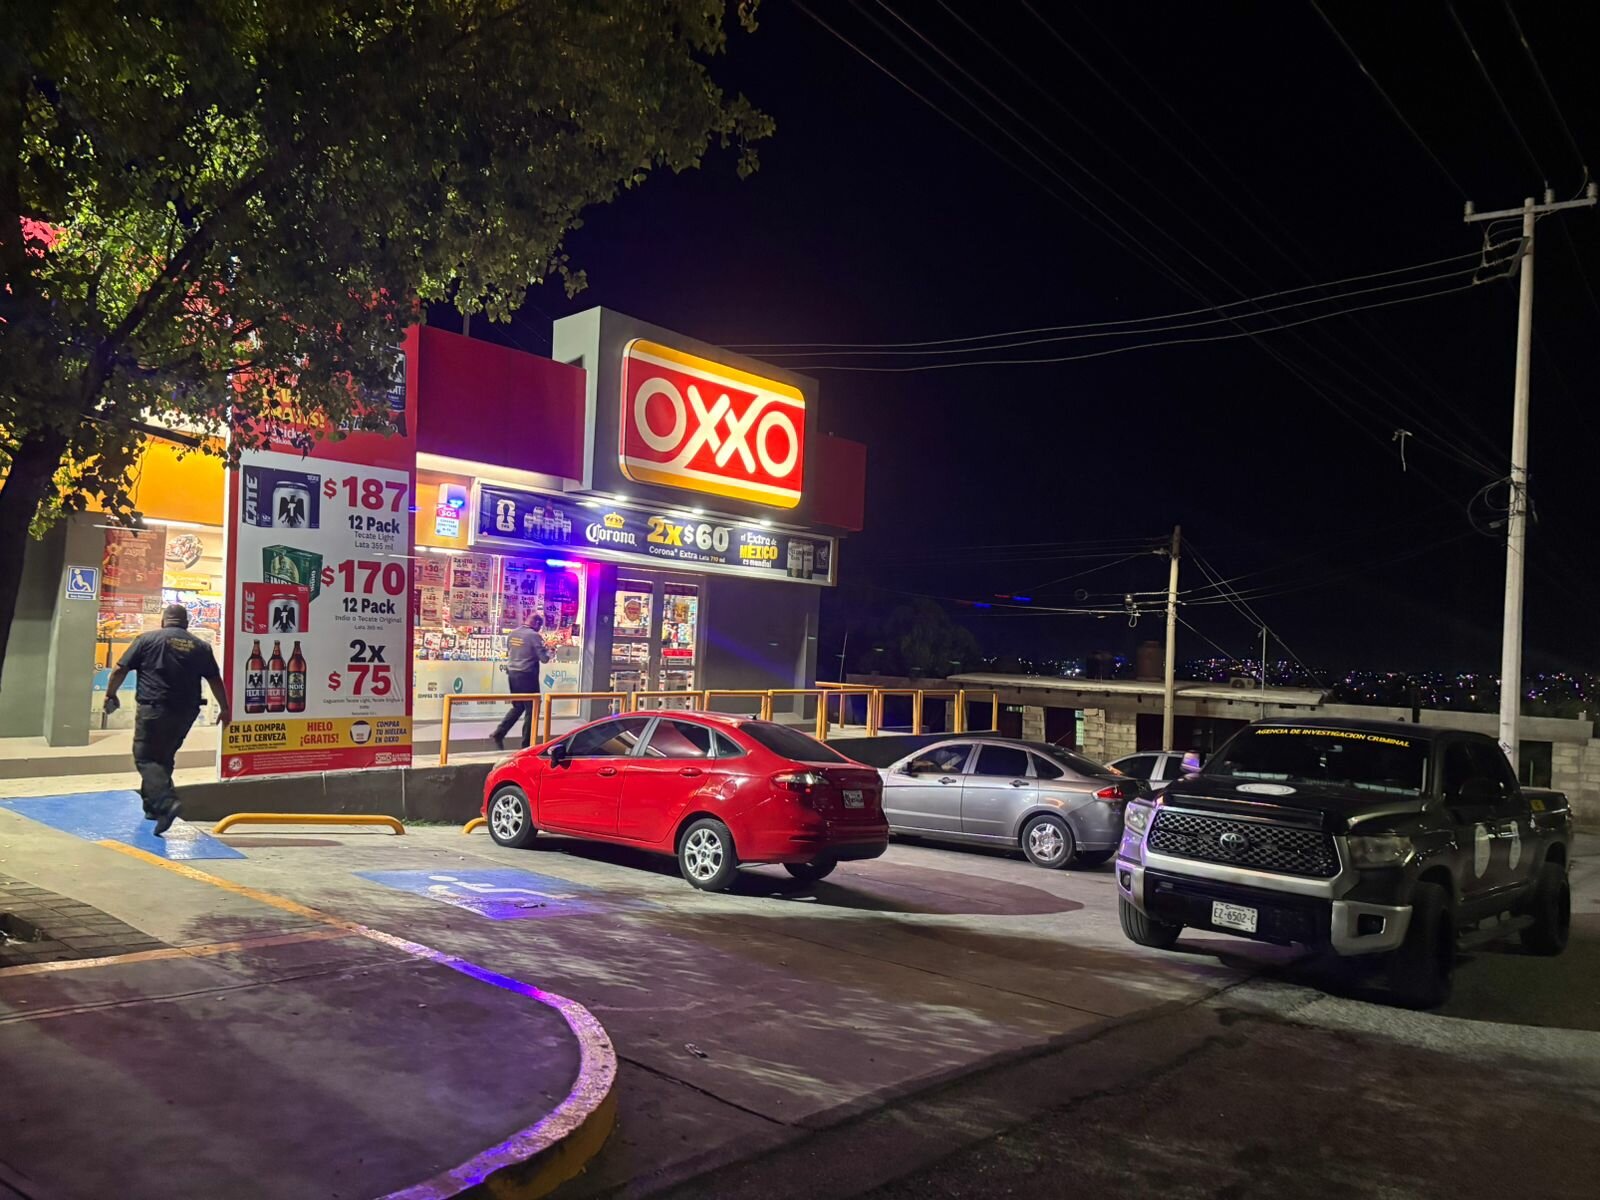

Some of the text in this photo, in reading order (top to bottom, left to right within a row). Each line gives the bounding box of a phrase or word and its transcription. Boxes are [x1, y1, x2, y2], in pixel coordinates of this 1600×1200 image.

[634, 377, 799, 478] OXXO
[323, 475, 408, 513] $187
[348, 514, 400, 534] 12 Pack
[354, 530, 395, 543] Tecate Light
[585, 522, 636, 545] Corona
[746, 532, 770, 546] Extra
[354, 541, 370, 549] Lata
[371, 541, 383, 550] 355
[679, 550, 698, 560] Extra
[749, 559, 772, 568] mundial
[321, 559, 406, 596] $170
[342, 597, 396, 615] 12 Pack
[349, 639, 386, 663] 2x
[327, 665, 391, 695] $75
[229, 723, 286, 734] EN LA COMPRA
[307, 721, 333, 732] HIELO
[376, 720, 400, 728] COMPRA
[229, 732, 287, 744] DE TU CERVEZA
[300, 733, 339, 747] ¡GRATIS!
[1366, 735, 1410, 747] CRIMINAL
